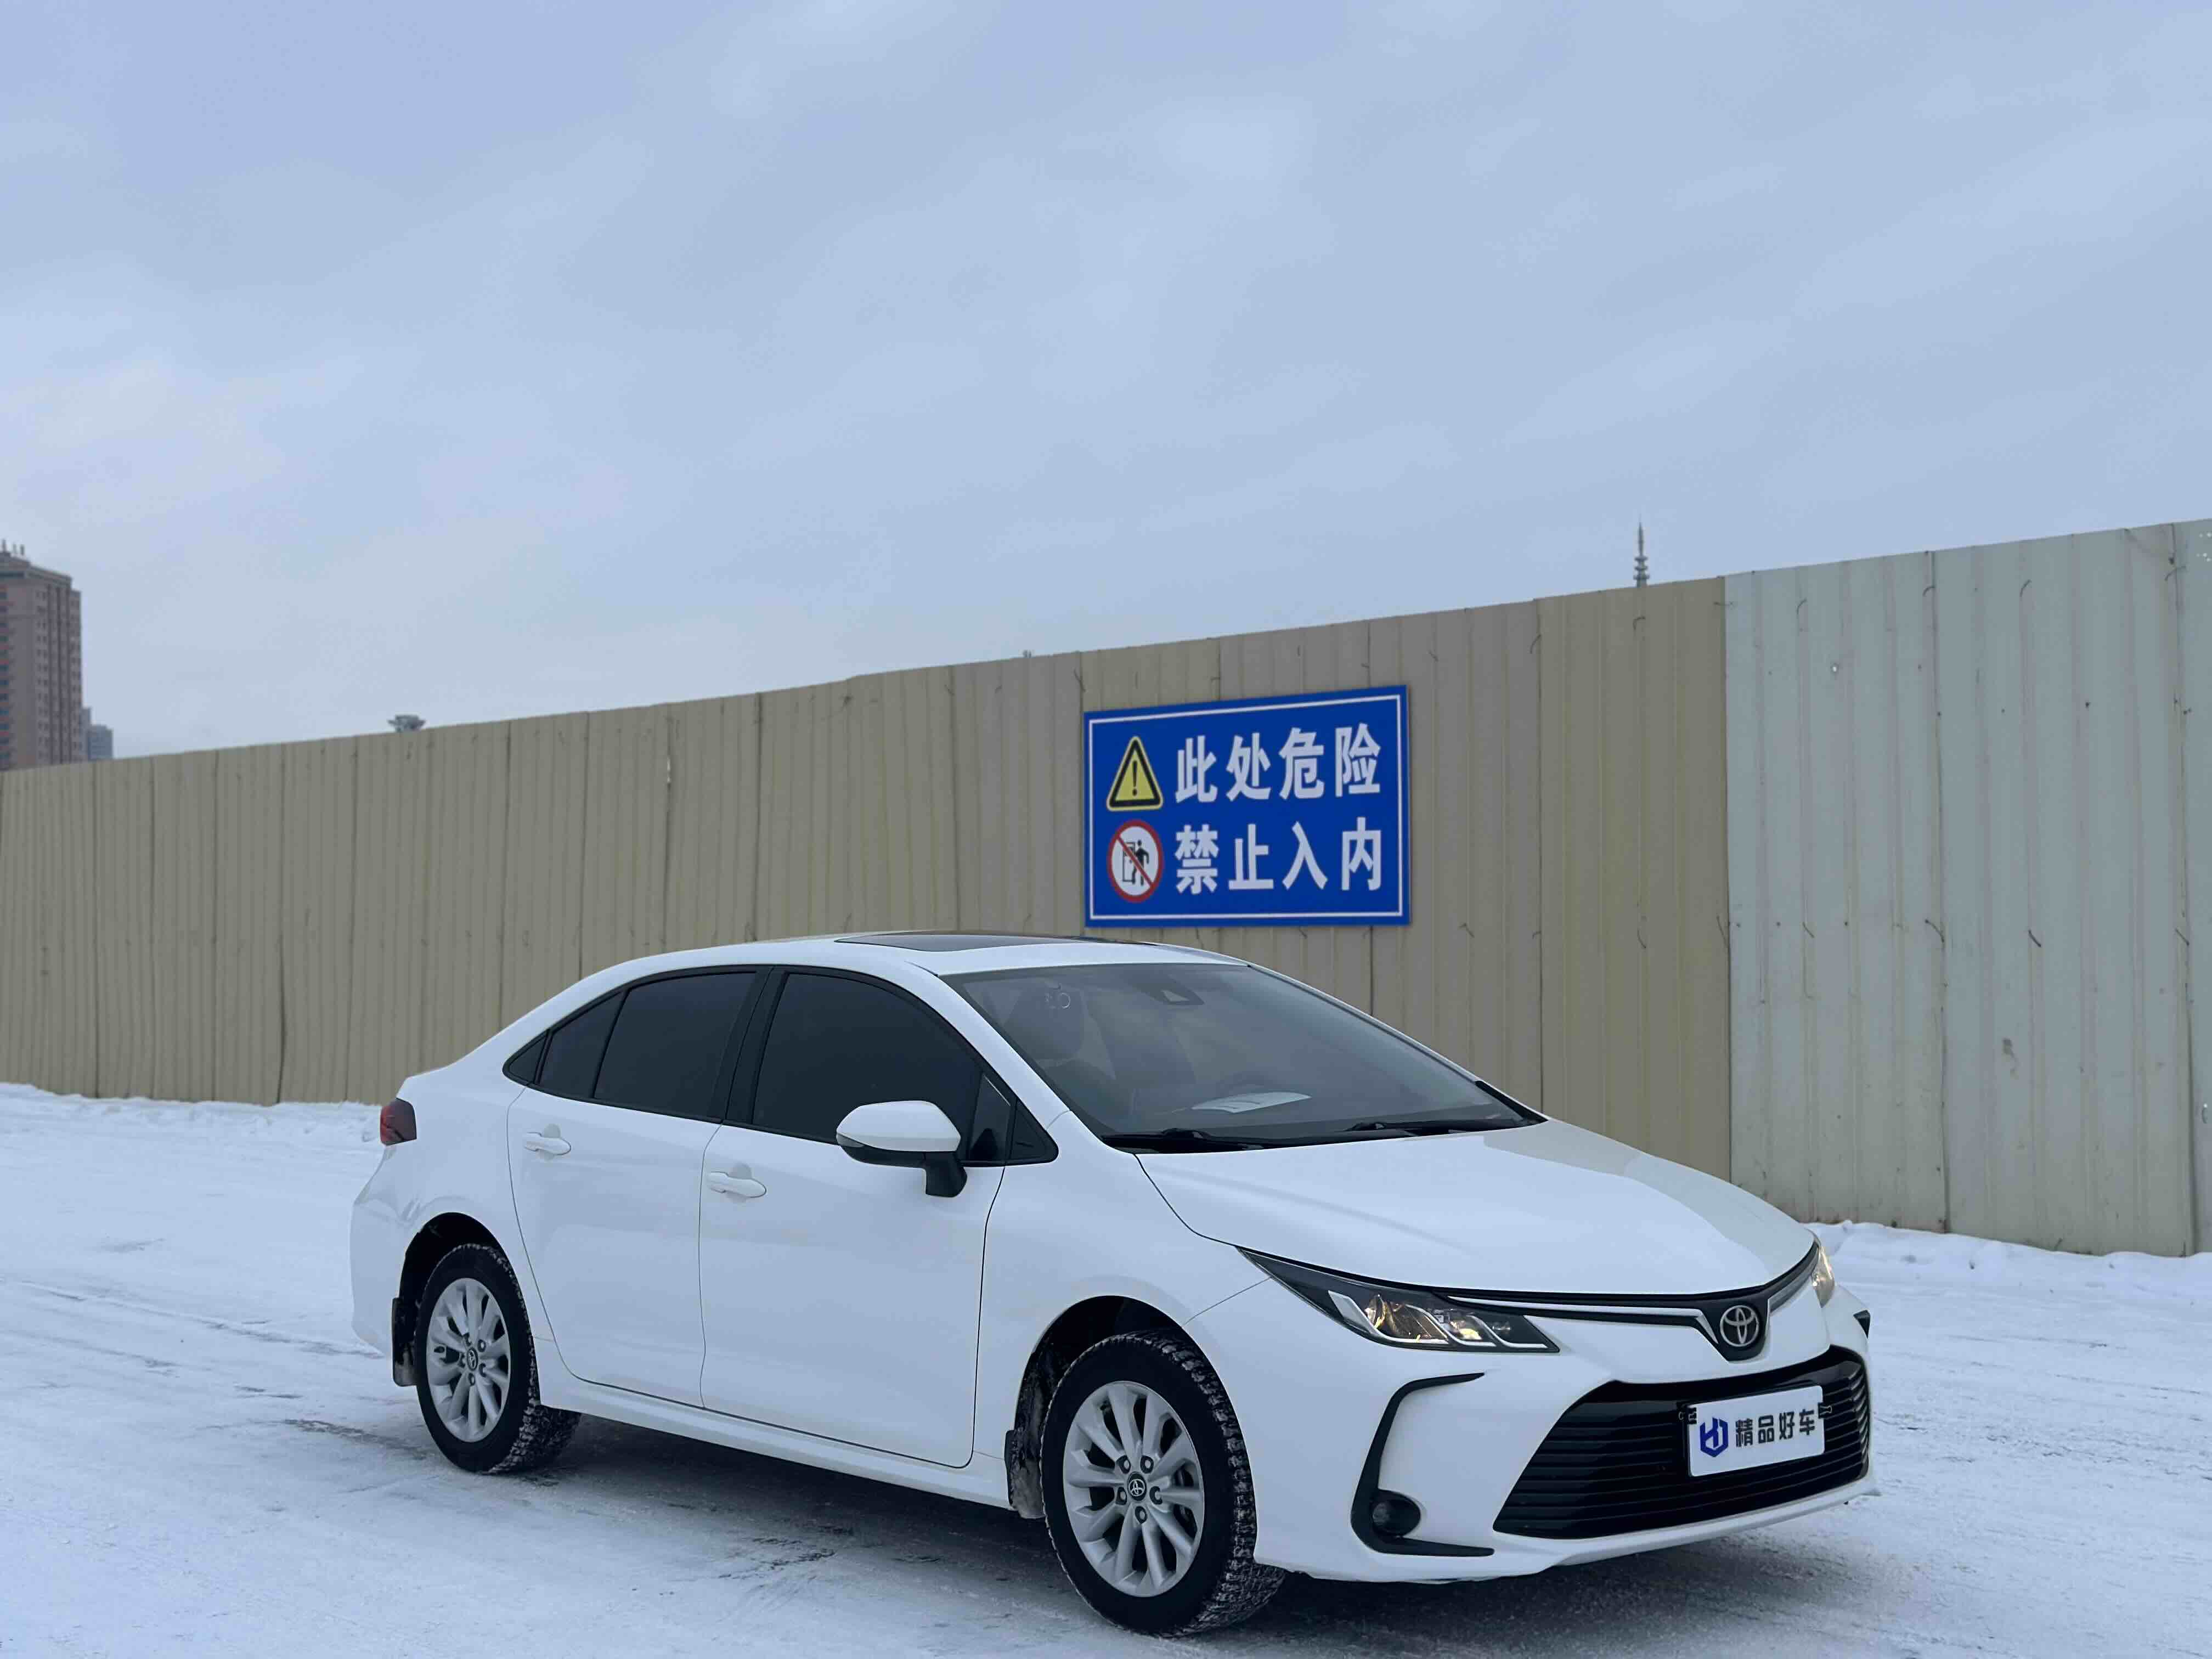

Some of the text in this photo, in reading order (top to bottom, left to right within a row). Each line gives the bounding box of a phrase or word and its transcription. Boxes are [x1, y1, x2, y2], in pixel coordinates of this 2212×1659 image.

[1175, 722, 1381, 804] 此处危险
[1174, 816, 1382, 895] 禁止入内
[1735, 1408, 1815, 1448] 精品好车
